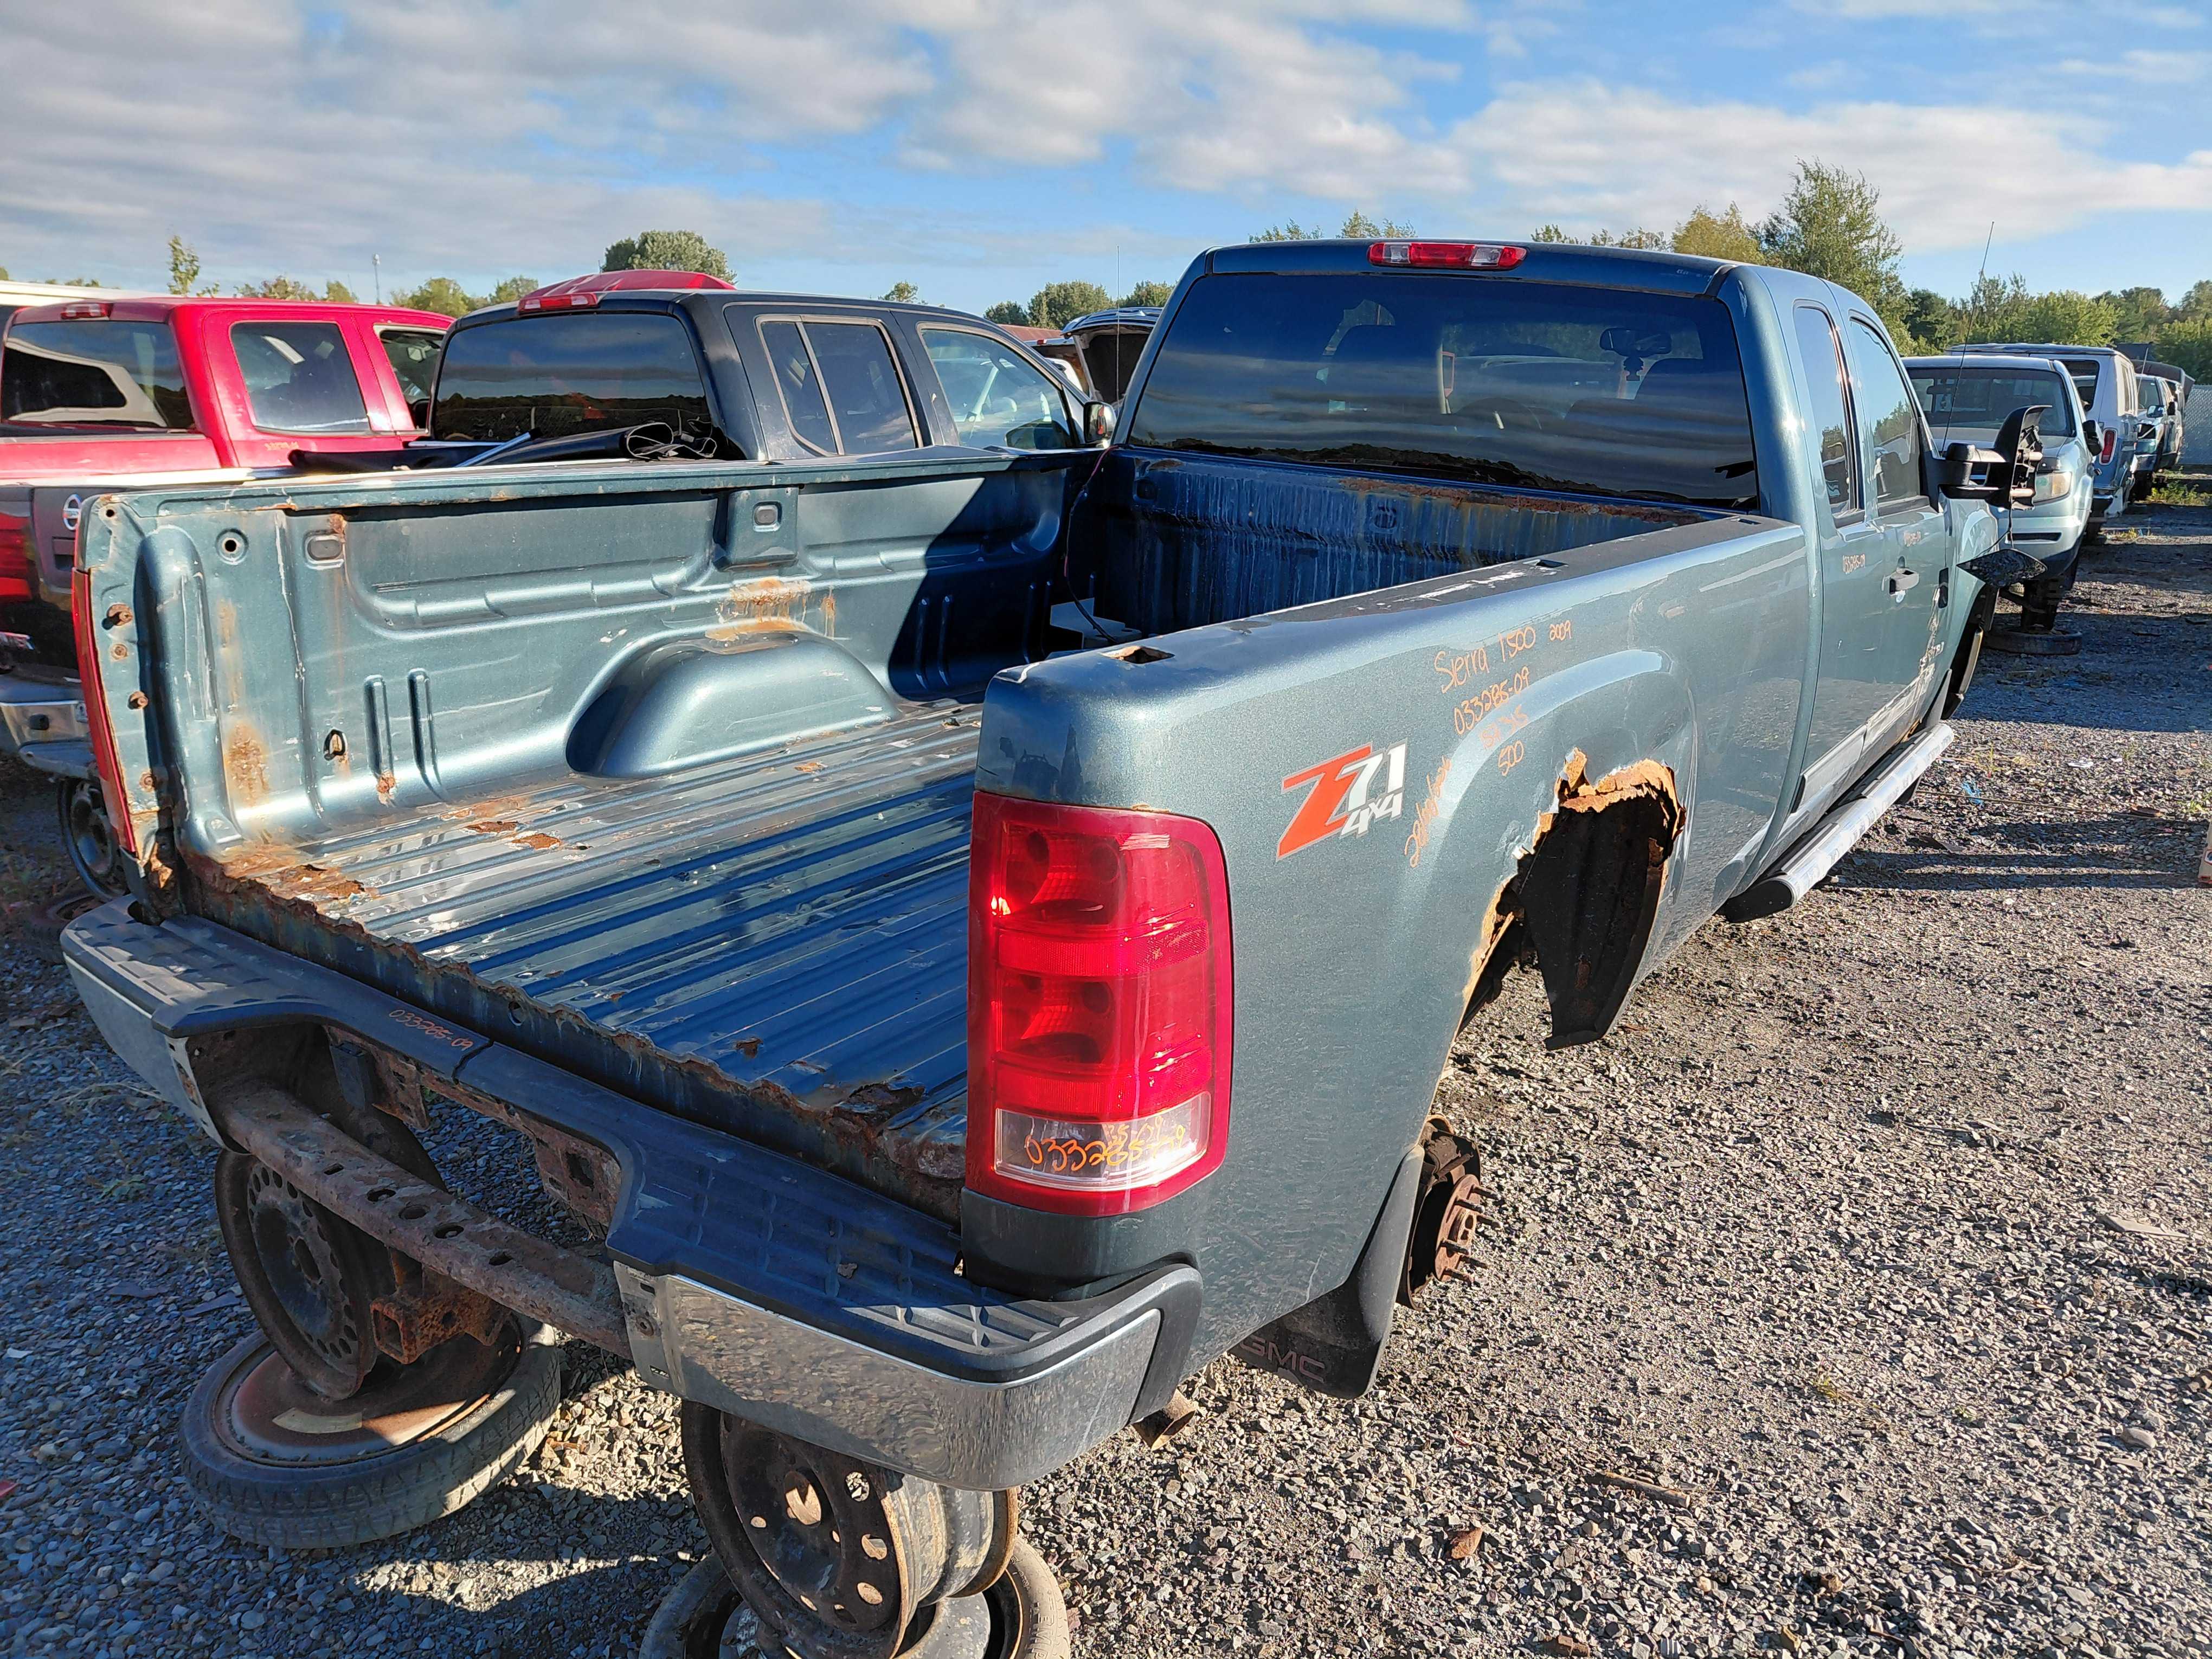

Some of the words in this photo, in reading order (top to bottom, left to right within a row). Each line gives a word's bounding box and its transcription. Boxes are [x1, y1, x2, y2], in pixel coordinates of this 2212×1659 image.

[1434, 647, 1490, 693] Sierra
[1498, 626, 1535, 662] 1500
[1549, 620, 1571, 641] 2009
[1454, 666, 1529, 735] 033285-09
[1276, 738, 1407, 861] Z71
[389, 1009, 473, 1051] 033285-09
[1240, 1335, 1325, 1382] GMC
